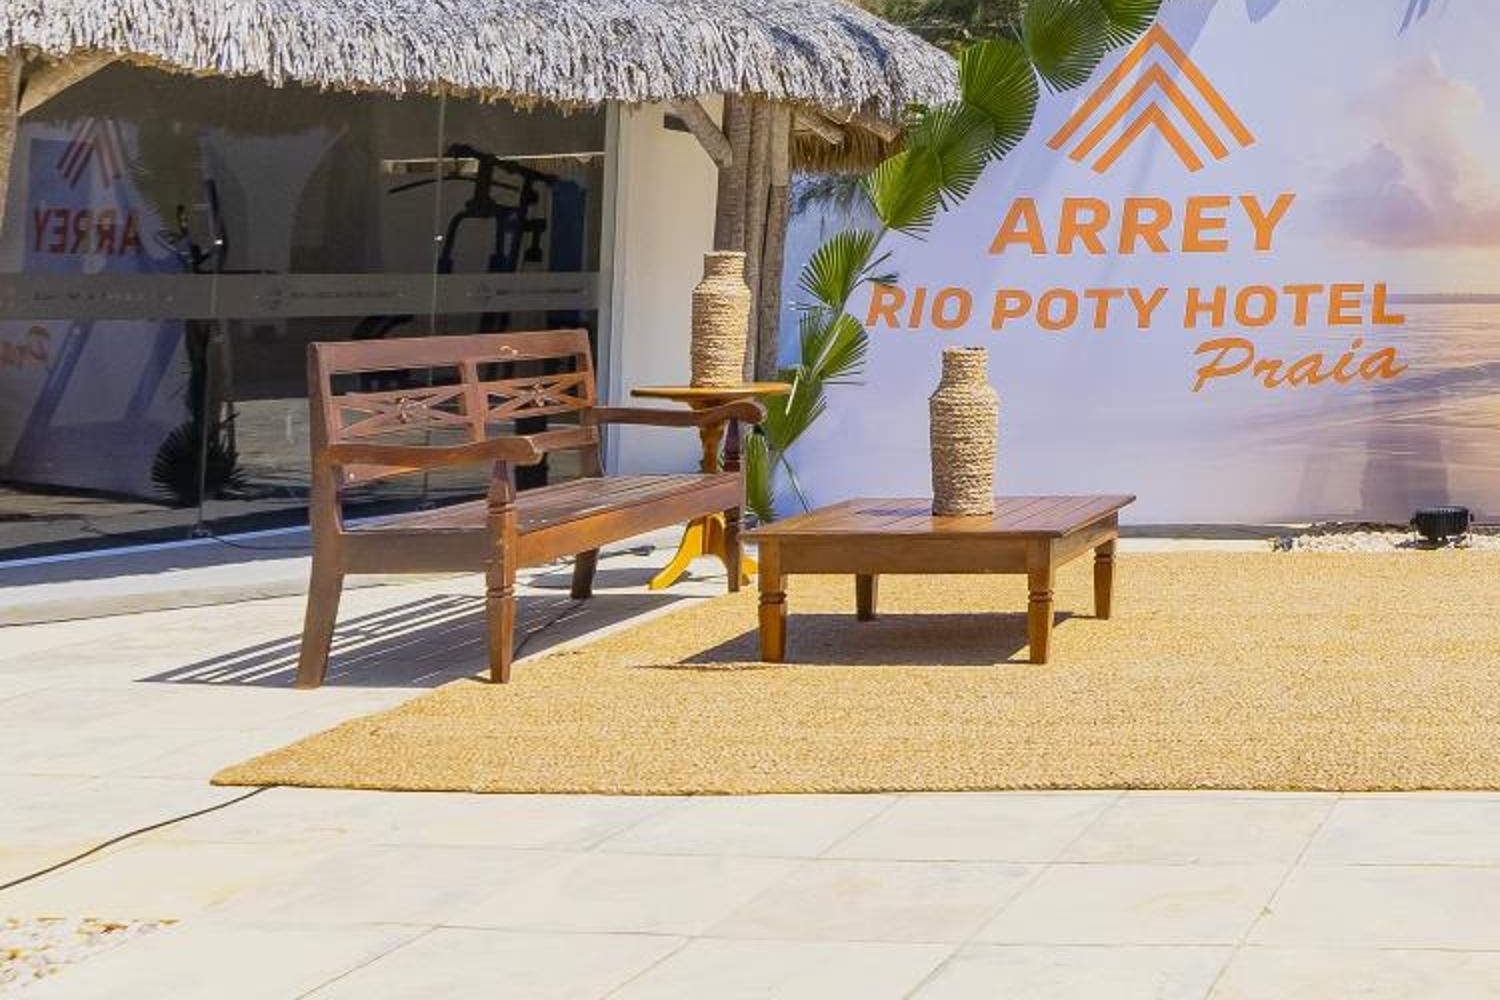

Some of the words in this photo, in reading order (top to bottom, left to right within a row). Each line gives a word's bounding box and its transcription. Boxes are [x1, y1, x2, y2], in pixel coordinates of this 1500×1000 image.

[989, 193, 1297, 255] ARREY
[865, 283, 974, 329] RIO
[991, 287, 1169, 330] POTY
[1184, 282, 1406, 328] HOTEL
[1192, 336, 1409, 393] Praia
